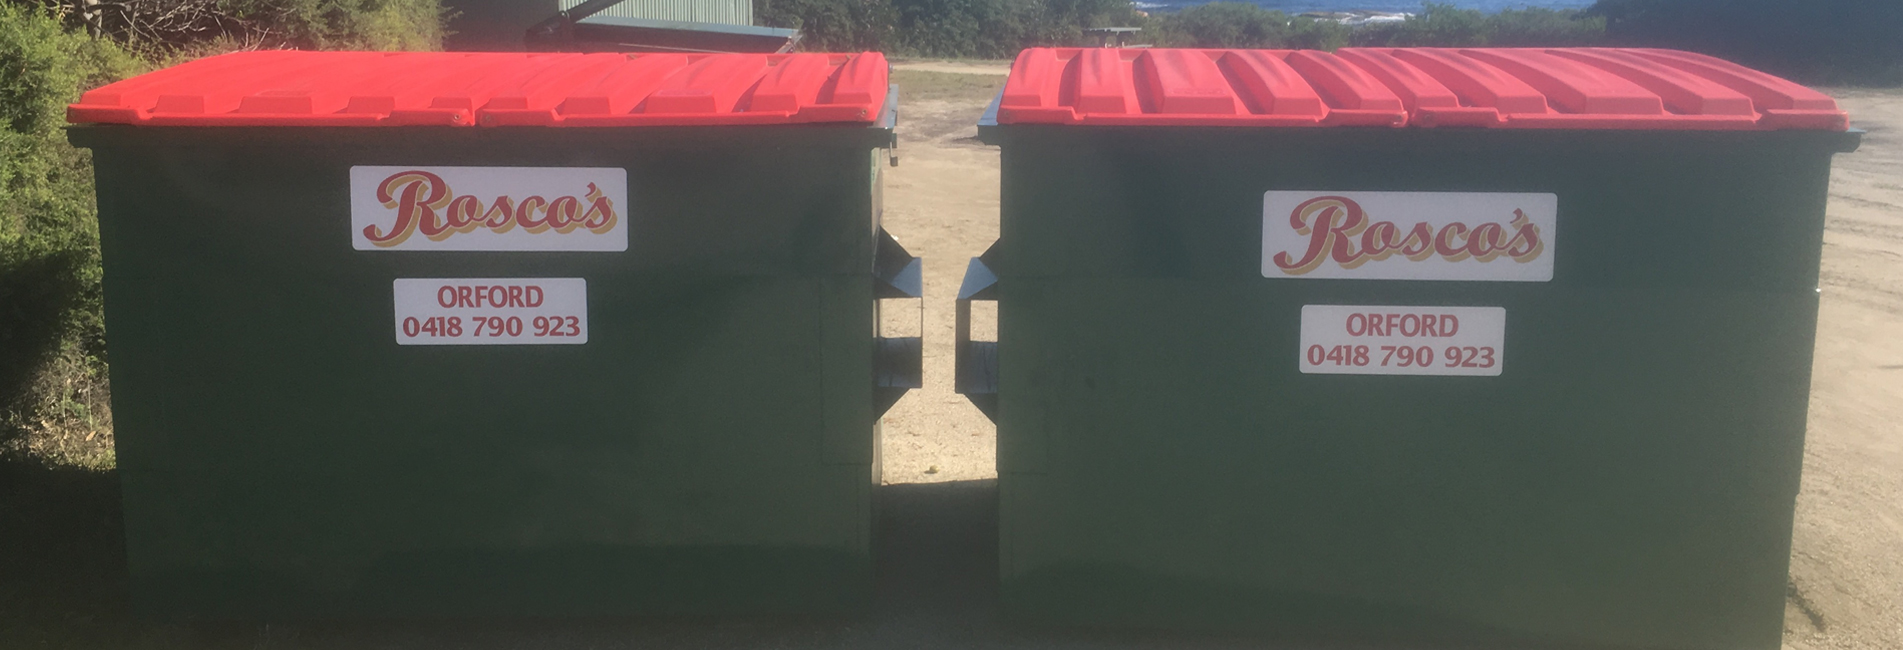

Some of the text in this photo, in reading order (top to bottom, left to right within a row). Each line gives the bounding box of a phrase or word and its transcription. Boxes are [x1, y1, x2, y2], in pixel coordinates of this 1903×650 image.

[363, 170, 617, 247] Rosco's
[1273, 196, 1544, 275] Rosco's
[437, 285, 544, 308] ORFORD
[403, 316, 581, 337] 0418 790 923
[1346, 313, 1459, 337] ORFORD
[1307, 344, 1495, 368] 0418 790 923
